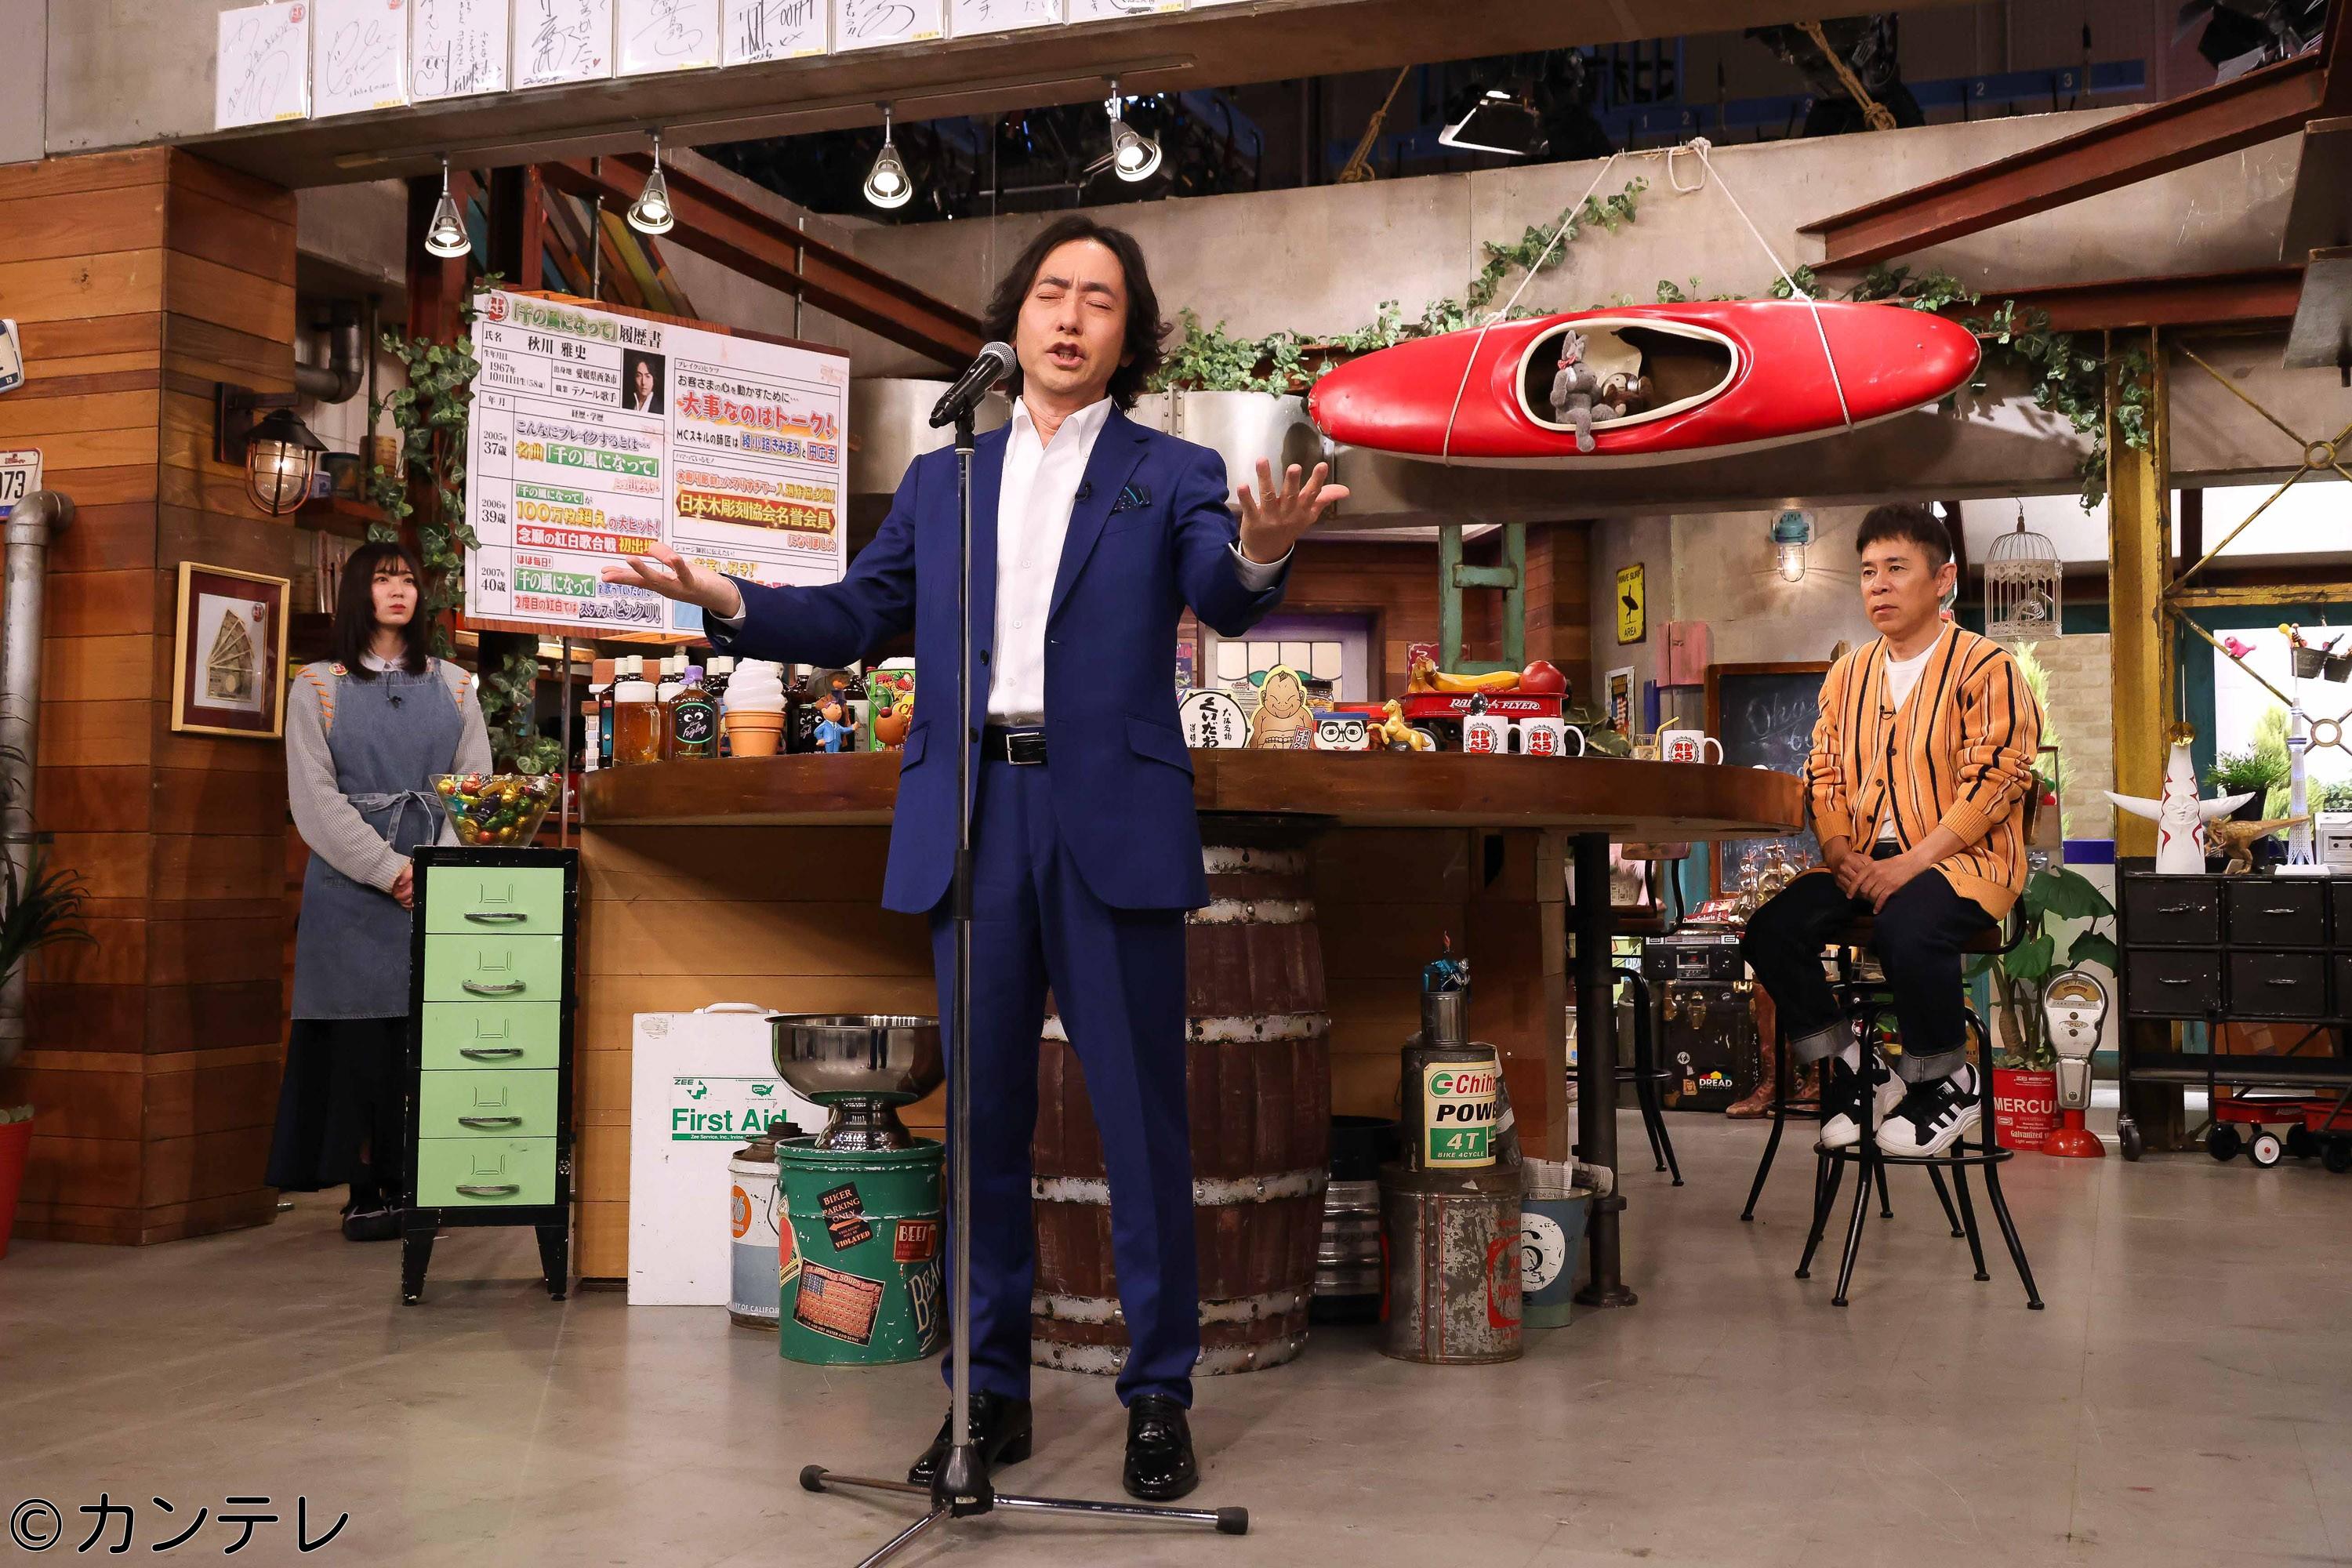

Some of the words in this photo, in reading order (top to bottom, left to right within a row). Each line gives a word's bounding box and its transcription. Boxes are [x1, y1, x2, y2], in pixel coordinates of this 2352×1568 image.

[485, 330, 502, 343] 氏名
[528, 336, 554, 354] 秋川
[561, 342, 586, 360] 雅史
[489, 361, 517, 375] 1967年
[554, 365, 572, 376] 出身地
[572, 387, 617, 403] テノール歌手
[484, 430, 507, 441] 2005年
[484, 441, 507, 456] 37歳
[481, 499, 506, 510] 2006年
[680, 493, 831, 530] 日本木彫刻協会名誉会員
[481, 510, 506, 524] 39歳
[787, 534, 837, 552] になりました
[481, 568, 506, 578] 2007年
[481, 579, 506, 593] 40歳
[1624, 627, 1637, 637] AREA
[1222, 708, 1232, 741] 大阪名物
[1699, 1078, 1733, 1087] DREAD
[673, 1108, 733, 1132] First
[2010, 1129, 2042, 1138] Galvanized
[1446, 1132, 1479, 1150] 4T
[823, 1189, 853, 1206] BIKER
[822, 1198, 860, 1216] PARKING
[833, 1210, 855, 1222] ONLY
[835, 1231, 871, 1248] VIOLATED
[839, 1274, 860, 1287] SOUPS
